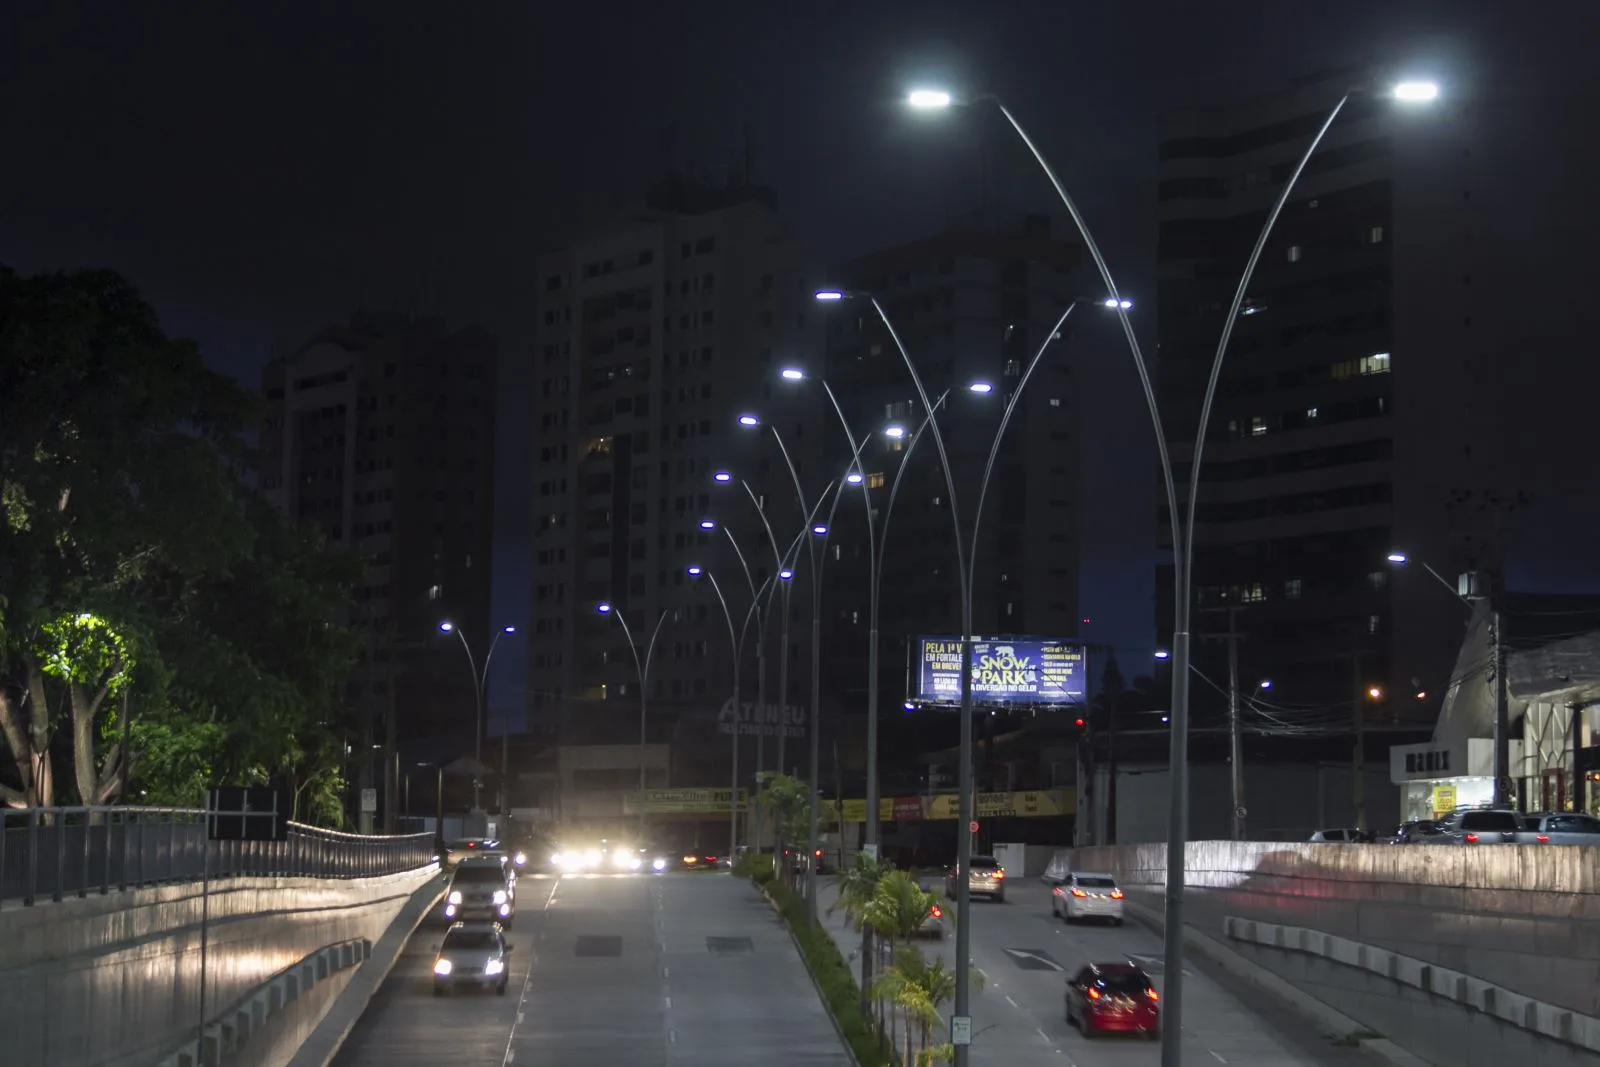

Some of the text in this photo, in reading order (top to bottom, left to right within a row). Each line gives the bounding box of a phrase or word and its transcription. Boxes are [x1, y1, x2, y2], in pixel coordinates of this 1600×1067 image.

[926, 642, 945, 653] PELA
[926, 653, 963, 662] EM FORTALE
[980, 655, 1030, 671] SNOW
[982, 670, 1028, 685] PARK
